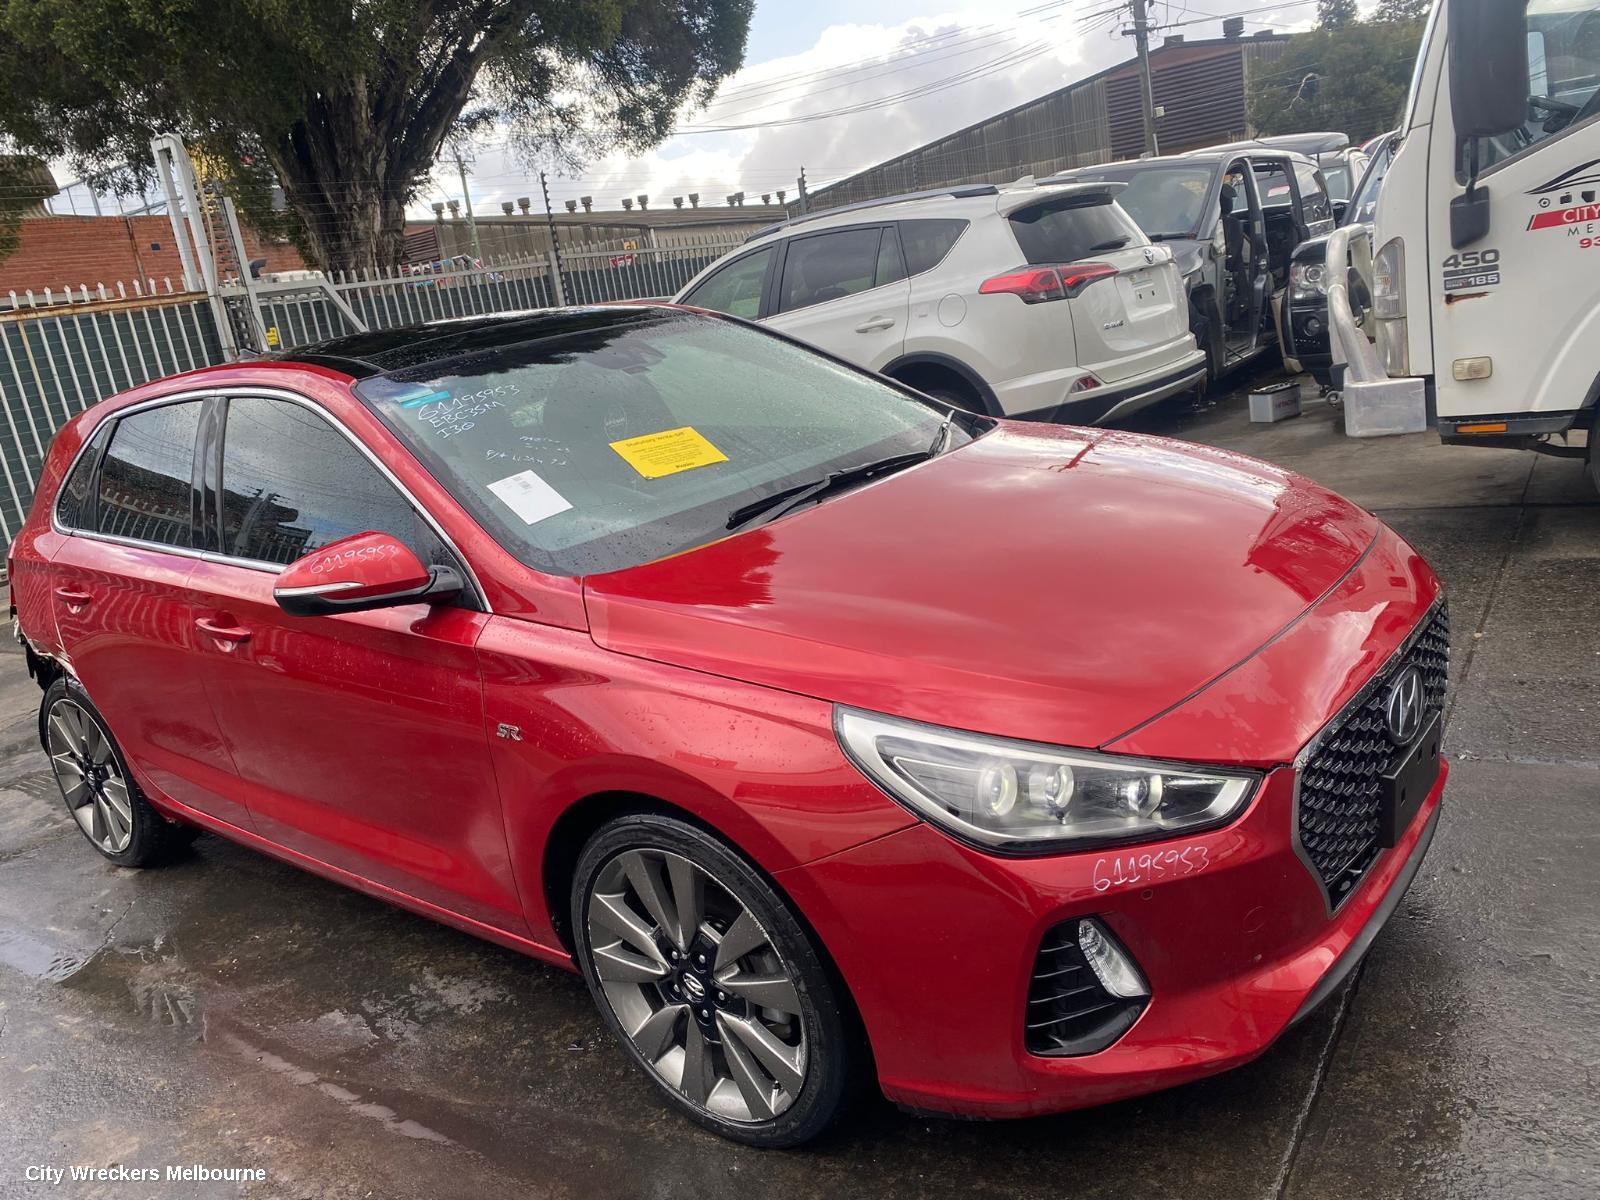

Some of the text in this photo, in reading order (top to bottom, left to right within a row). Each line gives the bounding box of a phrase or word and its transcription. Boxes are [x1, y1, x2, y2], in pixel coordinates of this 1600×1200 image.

[1563, 205, 1600, 223] CITY
[1442, 248, 1500, 269] 450
[1467, 274, 1499, 287] 185
[418, 384, 520, 421] 61195953
[310, 544, 399, 574] 61195953
[496, 723, 522, 741] SR
[1093, 846, 1210, 891] 61195953
